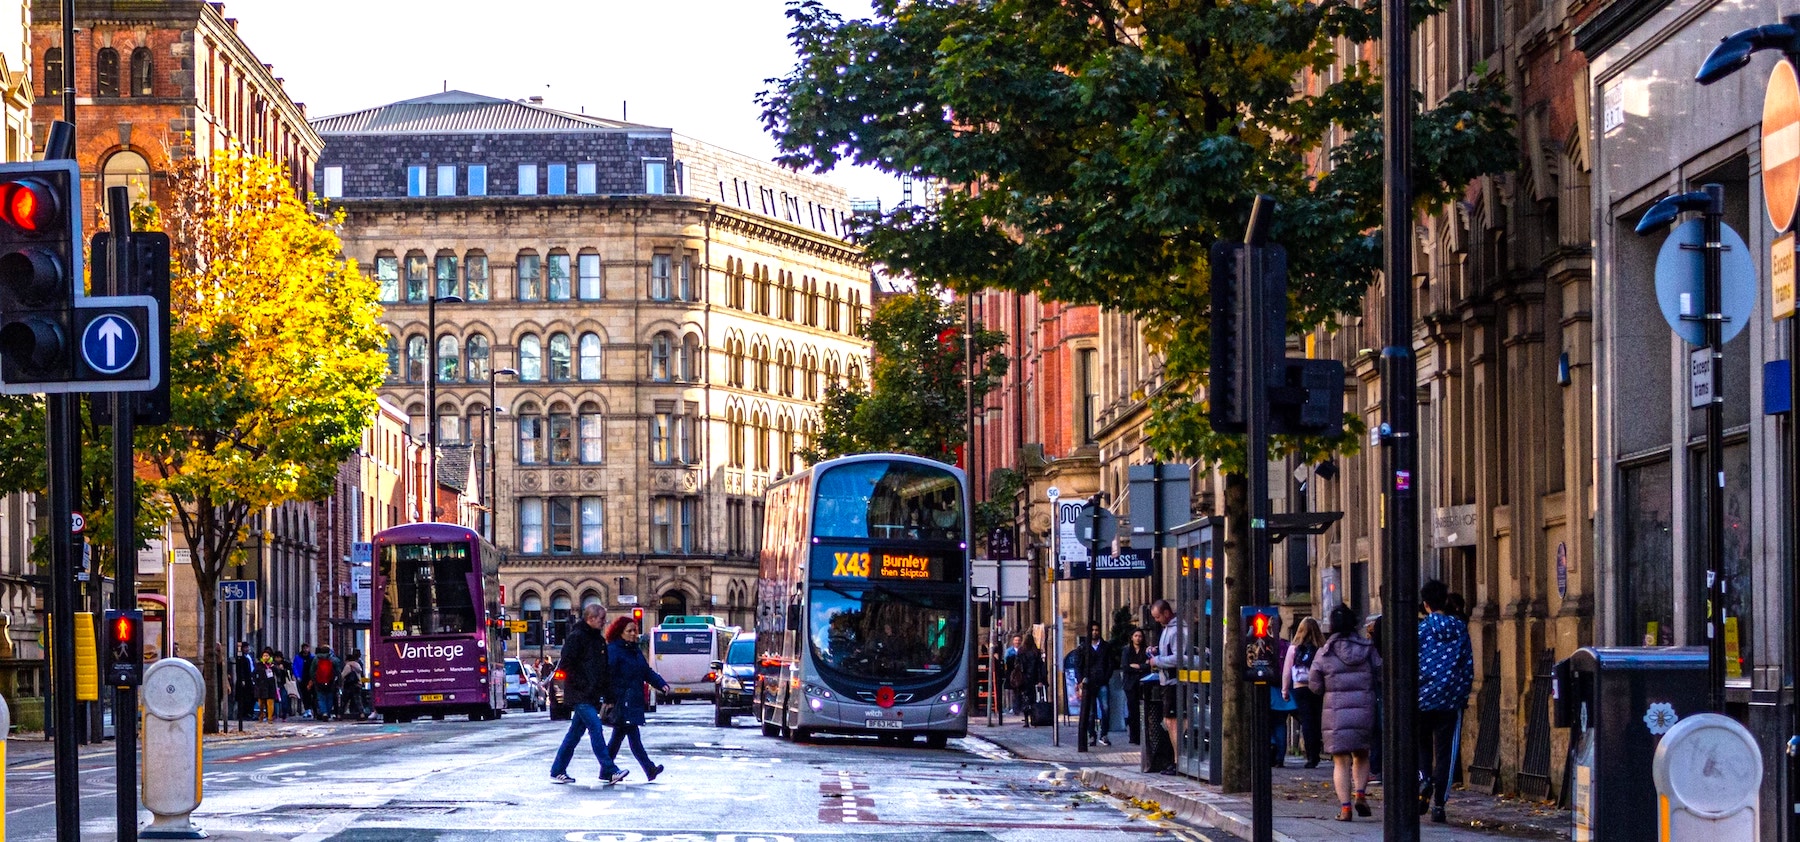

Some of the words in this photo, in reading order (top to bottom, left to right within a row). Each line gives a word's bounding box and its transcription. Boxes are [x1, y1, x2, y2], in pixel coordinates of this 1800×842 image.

[1773, 252, 1792, 277] Except
[1775, 281, 1791, 304] trams
[1693, 357, 1710, 377] Except
[1694, 380, 1709, 397] trams
[1048, 488, 1059, 497] SG
[832, 552, 871, 577] X43
[882, 554, 929, 570] Burnley
[881, 568, 898, 577] then
[900, 569, 929, 579] Skipton
[394, 643, 464, 661] Vantage
